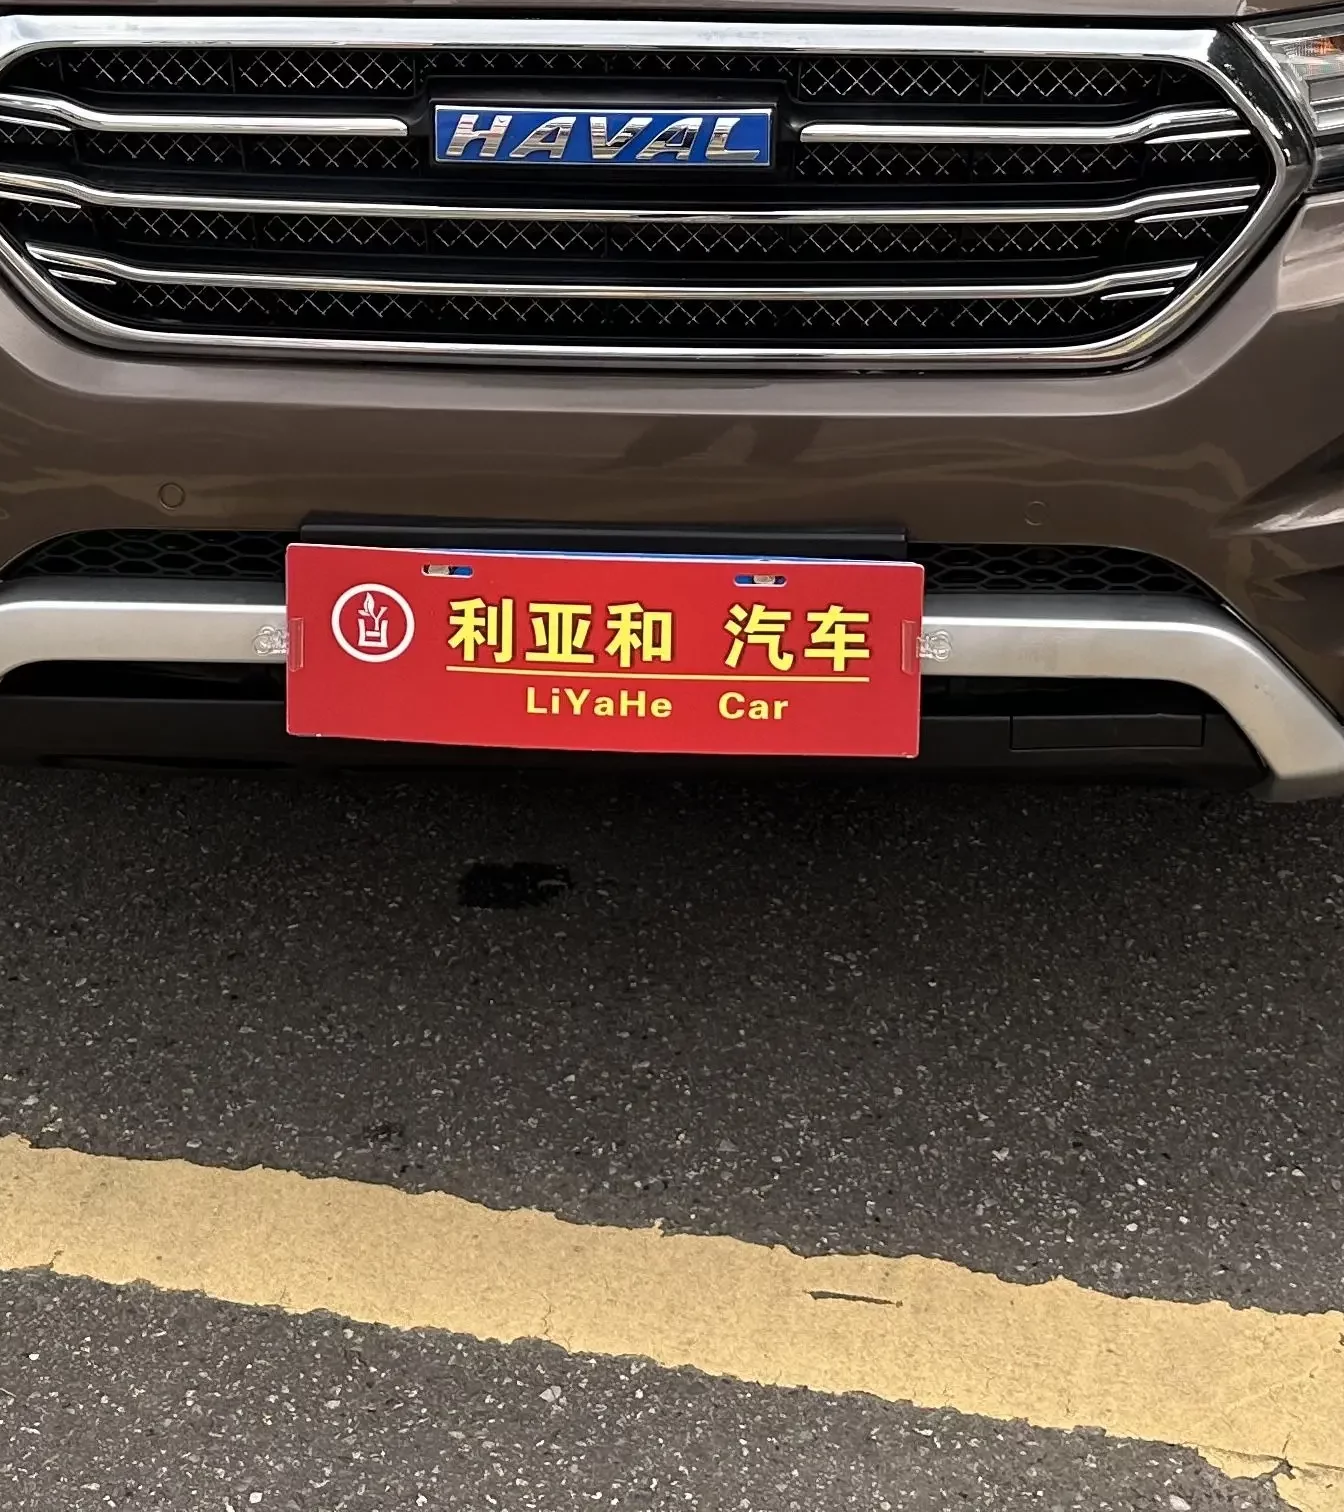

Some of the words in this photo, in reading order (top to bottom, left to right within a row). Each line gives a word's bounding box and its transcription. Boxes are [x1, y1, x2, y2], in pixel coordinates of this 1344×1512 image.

[445, 114, 761, 161] HAVAL
[447, 596, 674, 668] 利亚和
[724, 603, 872, 672] 汽车
[526, 686, 673, 719] LiYaHe
[717, 691, 789, 721] Car
